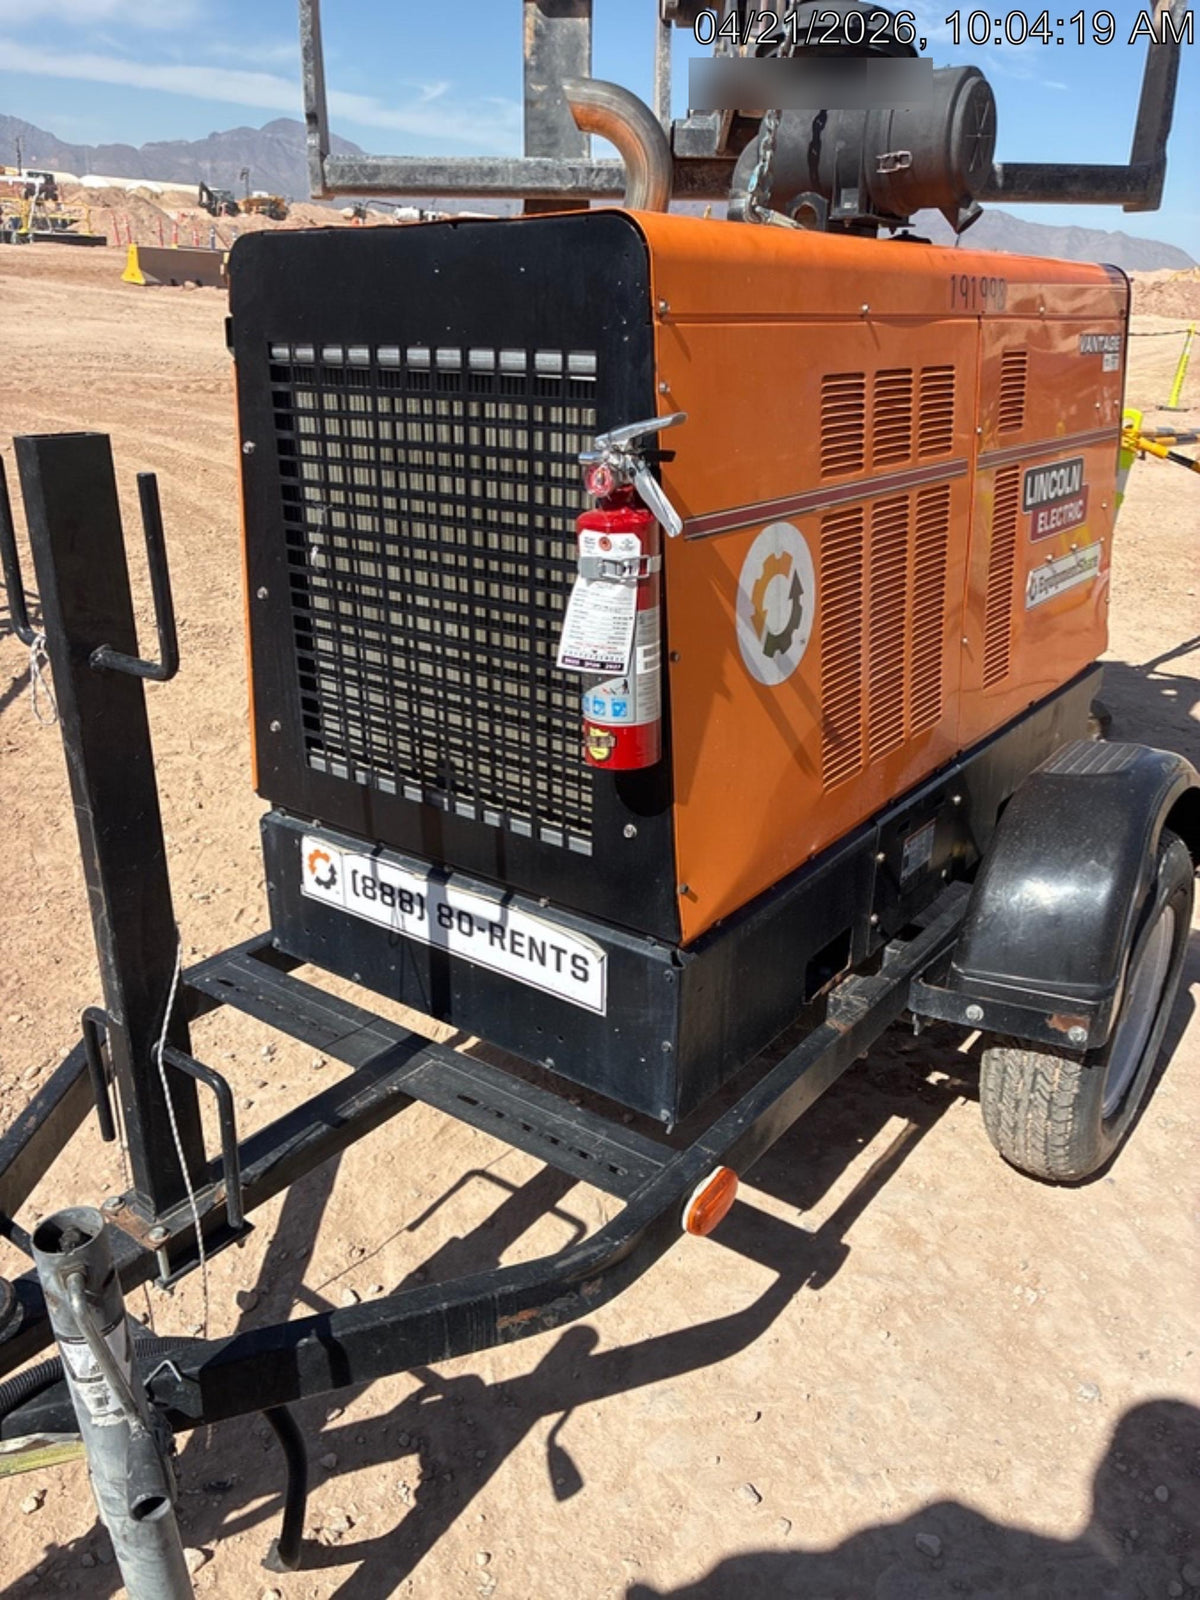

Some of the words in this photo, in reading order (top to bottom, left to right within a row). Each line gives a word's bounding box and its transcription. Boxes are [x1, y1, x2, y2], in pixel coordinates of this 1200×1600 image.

[1080, 335, 1120, 353] VANTAGE
[1026, 464, 1081, 506] LINCOLN
[1037, 499, 1084, 534] ELECTRIC
[351, 868, 426, 920] (888)
[436, 903, 590, 983] 80-RENTS
